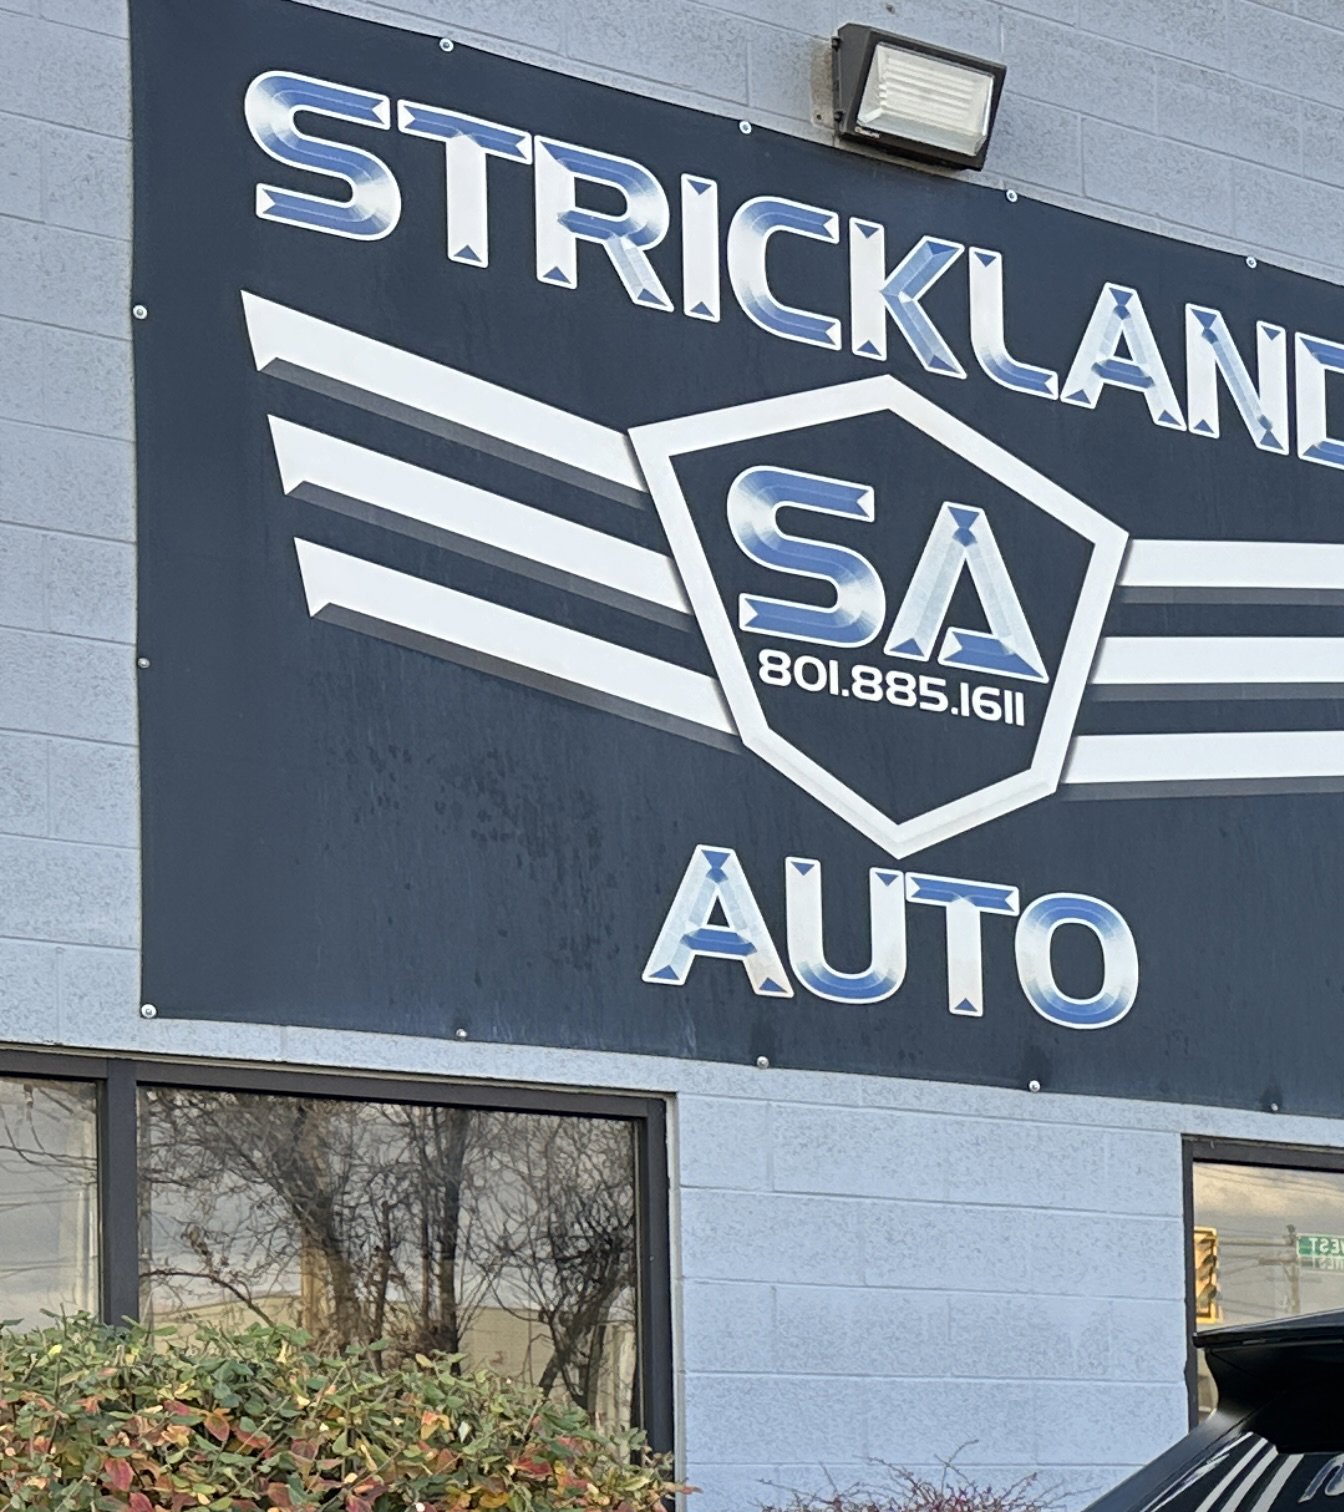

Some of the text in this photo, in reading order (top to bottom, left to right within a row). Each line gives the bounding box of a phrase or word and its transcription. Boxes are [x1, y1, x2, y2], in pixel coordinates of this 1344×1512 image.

[727, 466, 1049, 683] SA
[758, 648, 1025, 727] 801.885.1611
[642, 844, 1139, 1029] AUTO
